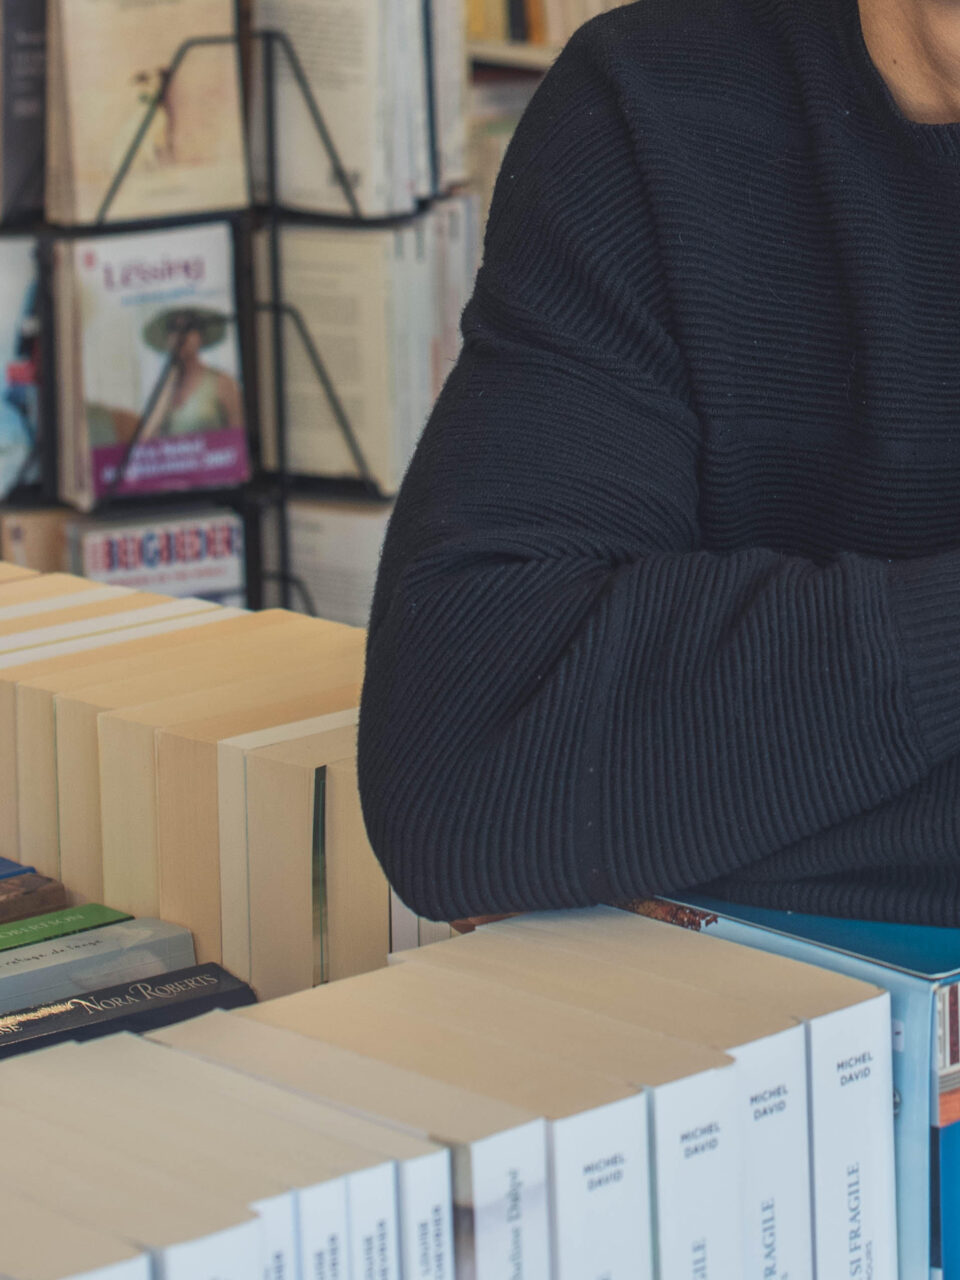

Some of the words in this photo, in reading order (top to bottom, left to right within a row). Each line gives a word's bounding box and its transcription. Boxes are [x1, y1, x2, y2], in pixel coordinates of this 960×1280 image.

[836, 1051, 873, 1071] MICHEL
[840, 1067, 871, 1086] DAVID
[750, 1084, 788, 1105] MICHEL
[753, 1100, 786, 1120] DAVID
[680, 1122, 720, 1143] MICHEL
[684, 1138, 718, 1158] DAVID
[583, 1153, 625, 1175] MICHEL
[588, 1170, 623, 1191] DAVID
[847, 1162, 862, 1254] FRAGILE
[850, 1257, 862, 1277] SI
